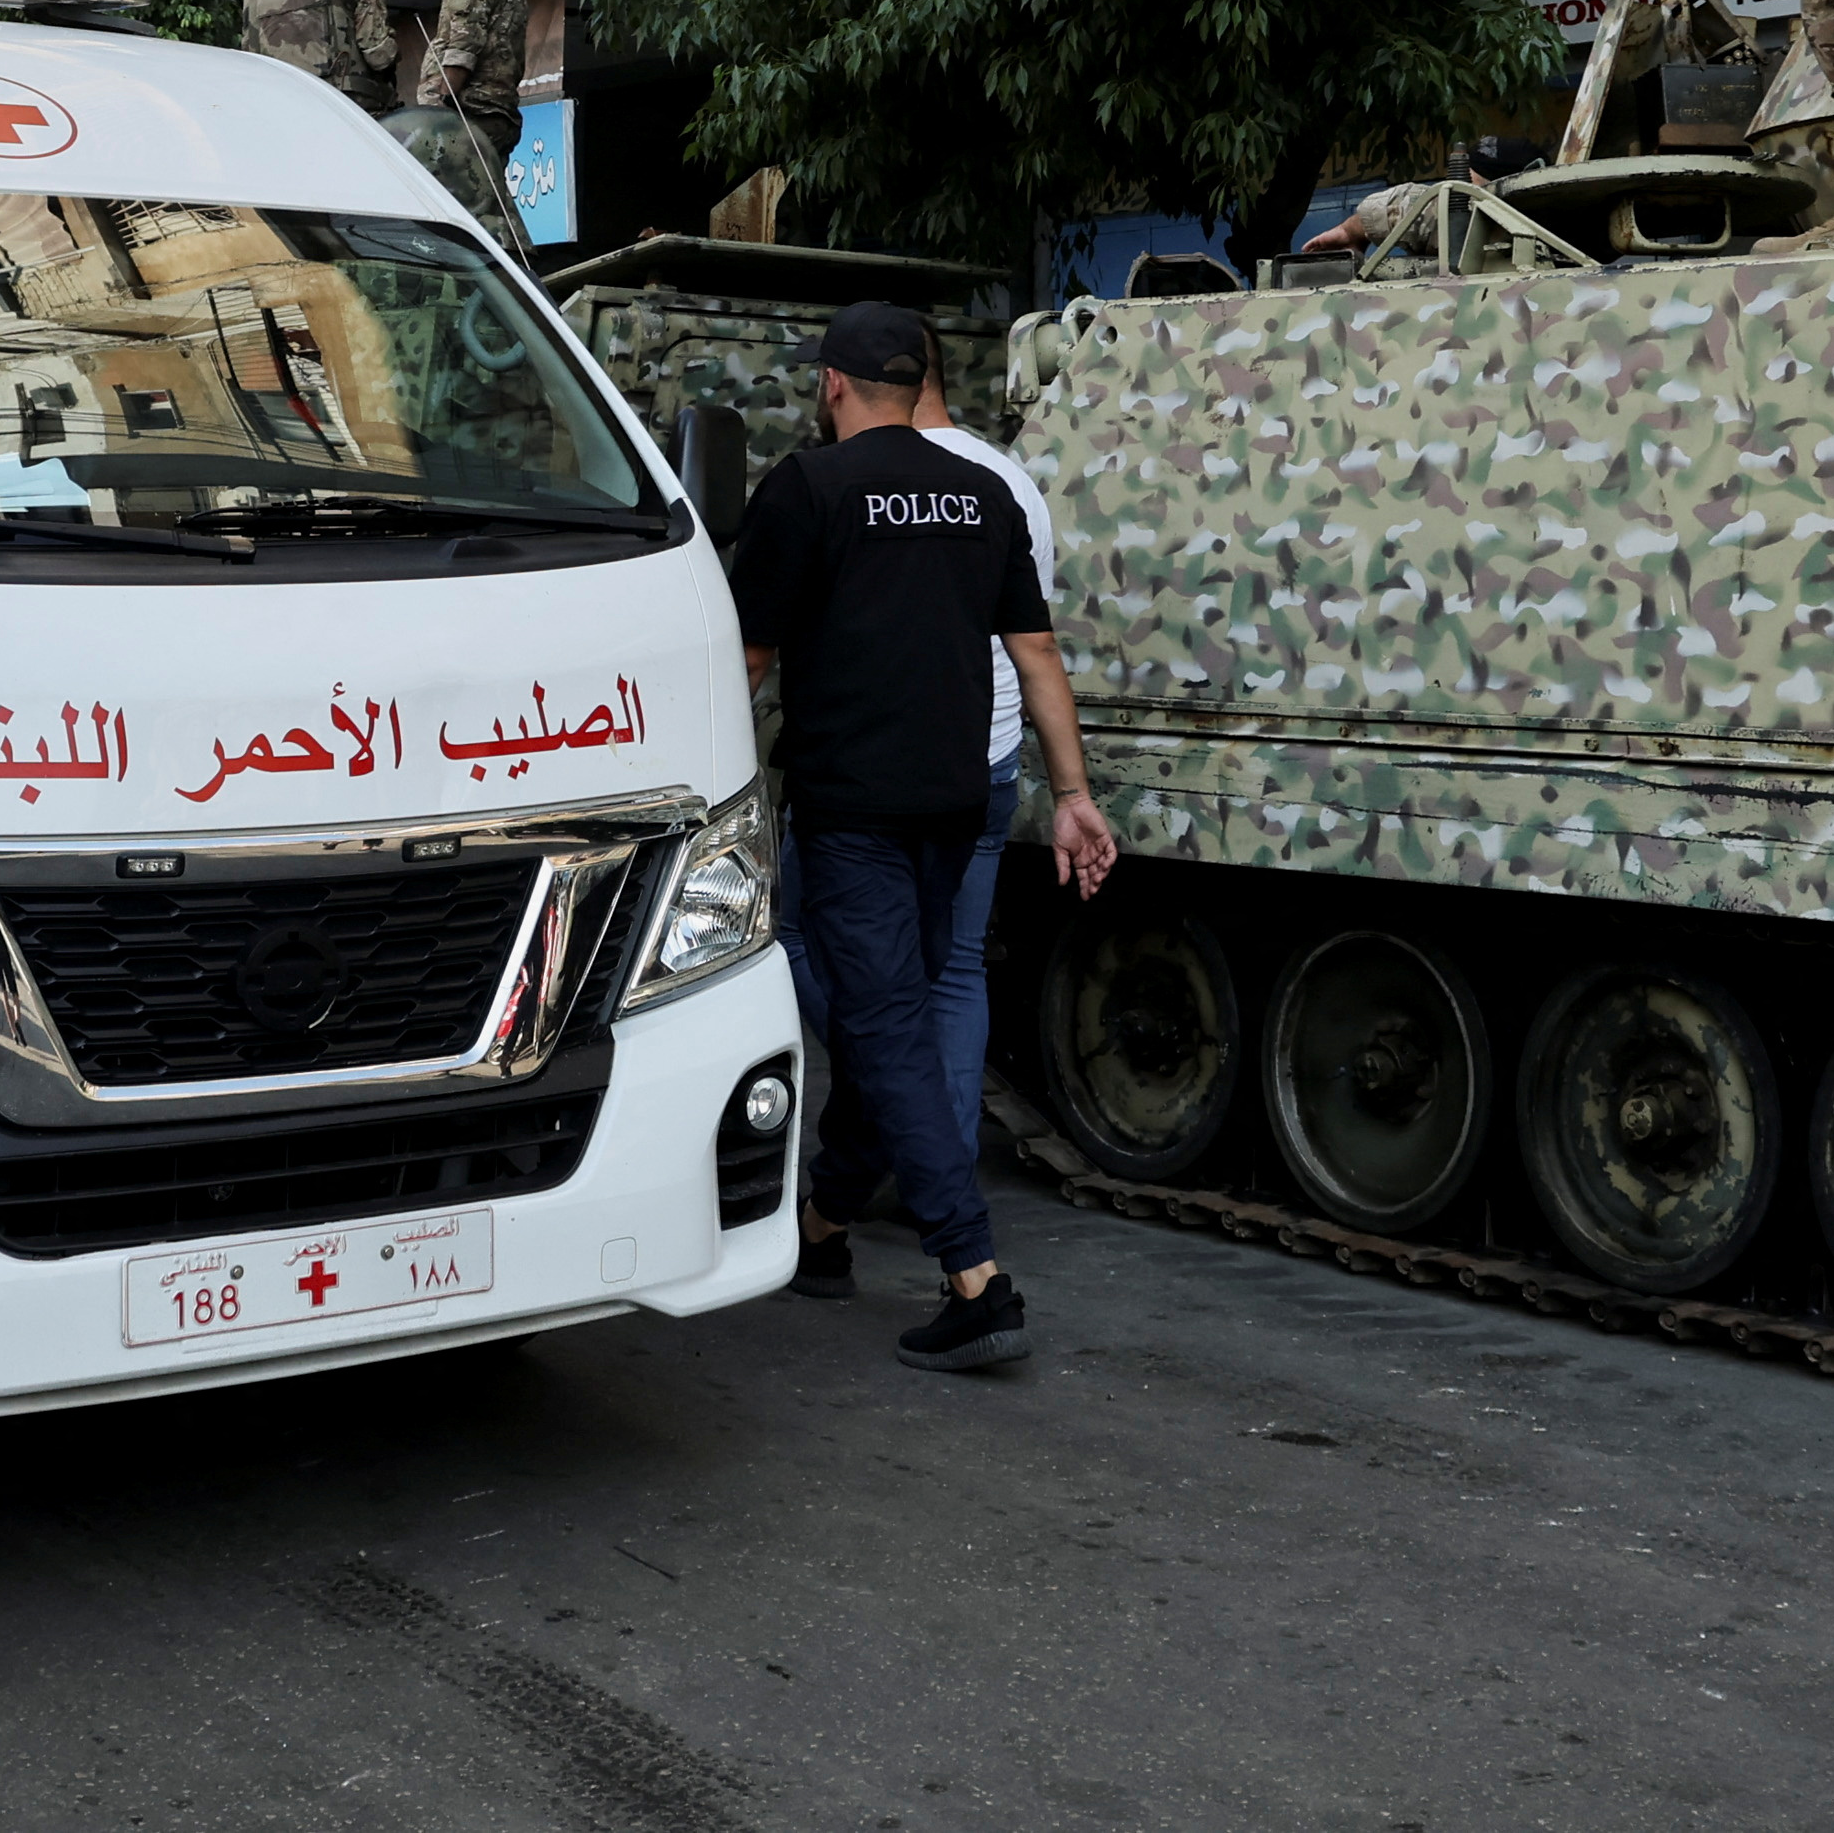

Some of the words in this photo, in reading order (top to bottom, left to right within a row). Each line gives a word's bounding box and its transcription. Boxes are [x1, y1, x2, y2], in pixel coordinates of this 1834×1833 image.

[865, 493, 981, 526] POLICE
[175, 681, 402, 804] الأحمر
[439, 673, 646, 782] الصليب
[392, 1217, 461, 1252] الصليب
[159, 1252, 228, 1293] اللبناني
[408, 1254, 462, 1293] ١٨٨
[170, 1283, 242, 1330] 188
